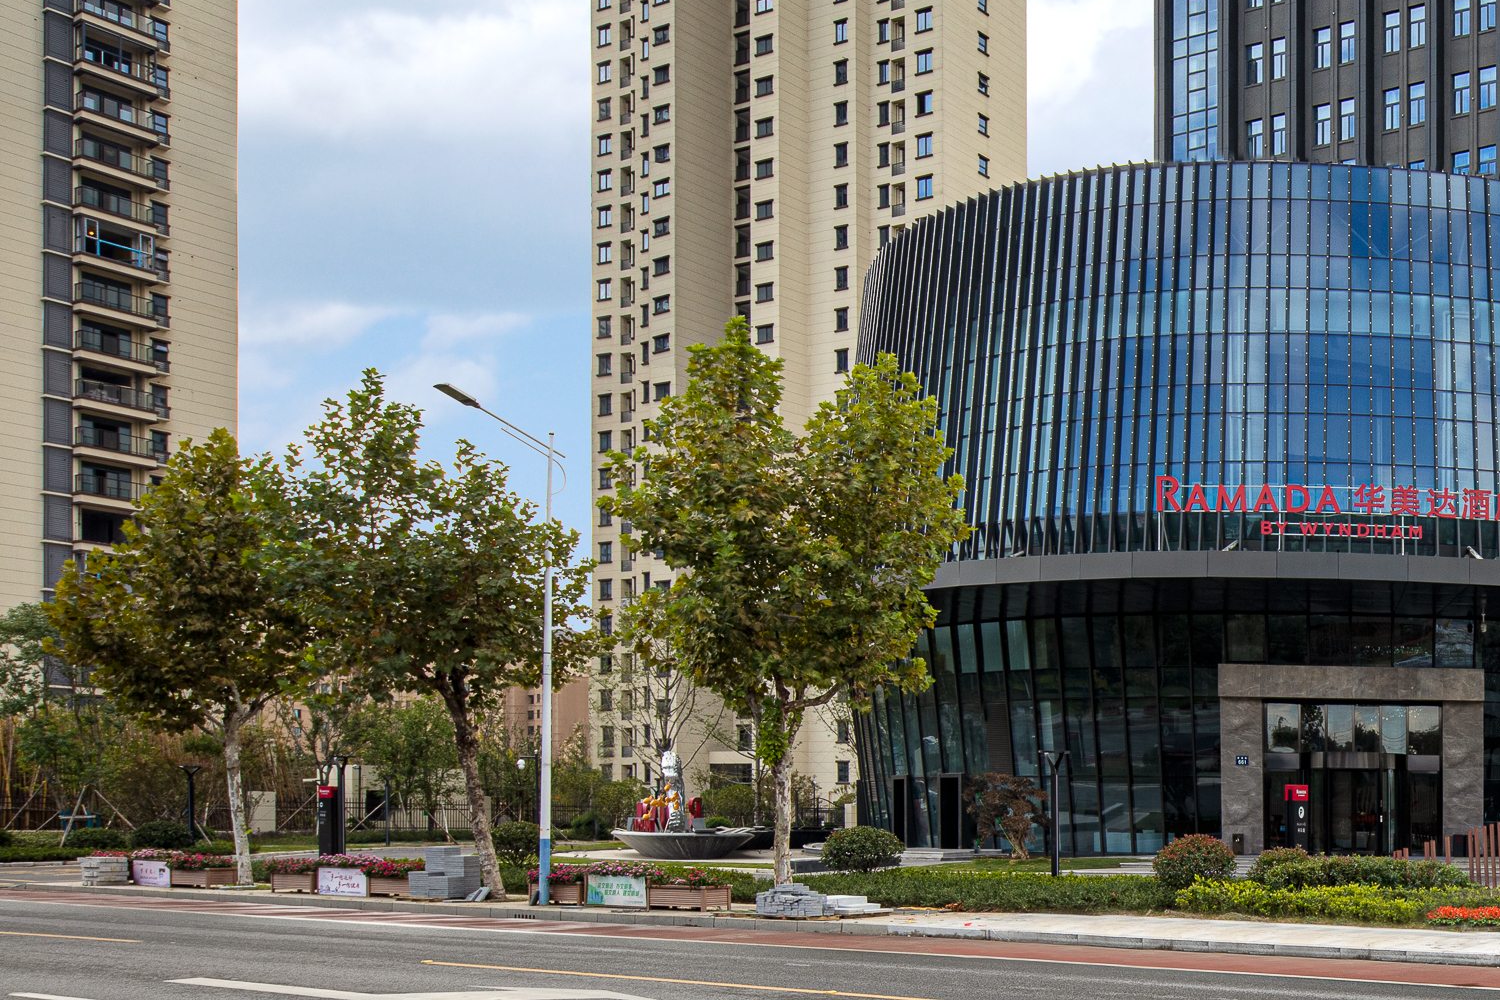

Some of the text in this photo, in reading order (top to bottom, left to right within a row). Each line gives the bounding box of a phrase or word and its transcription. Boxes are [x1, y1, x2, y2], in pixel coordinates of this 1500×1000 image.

[1156, 475, 1342, 514] RAMADA
[1260, 520, 1423, 540] BY WYNDHAM
